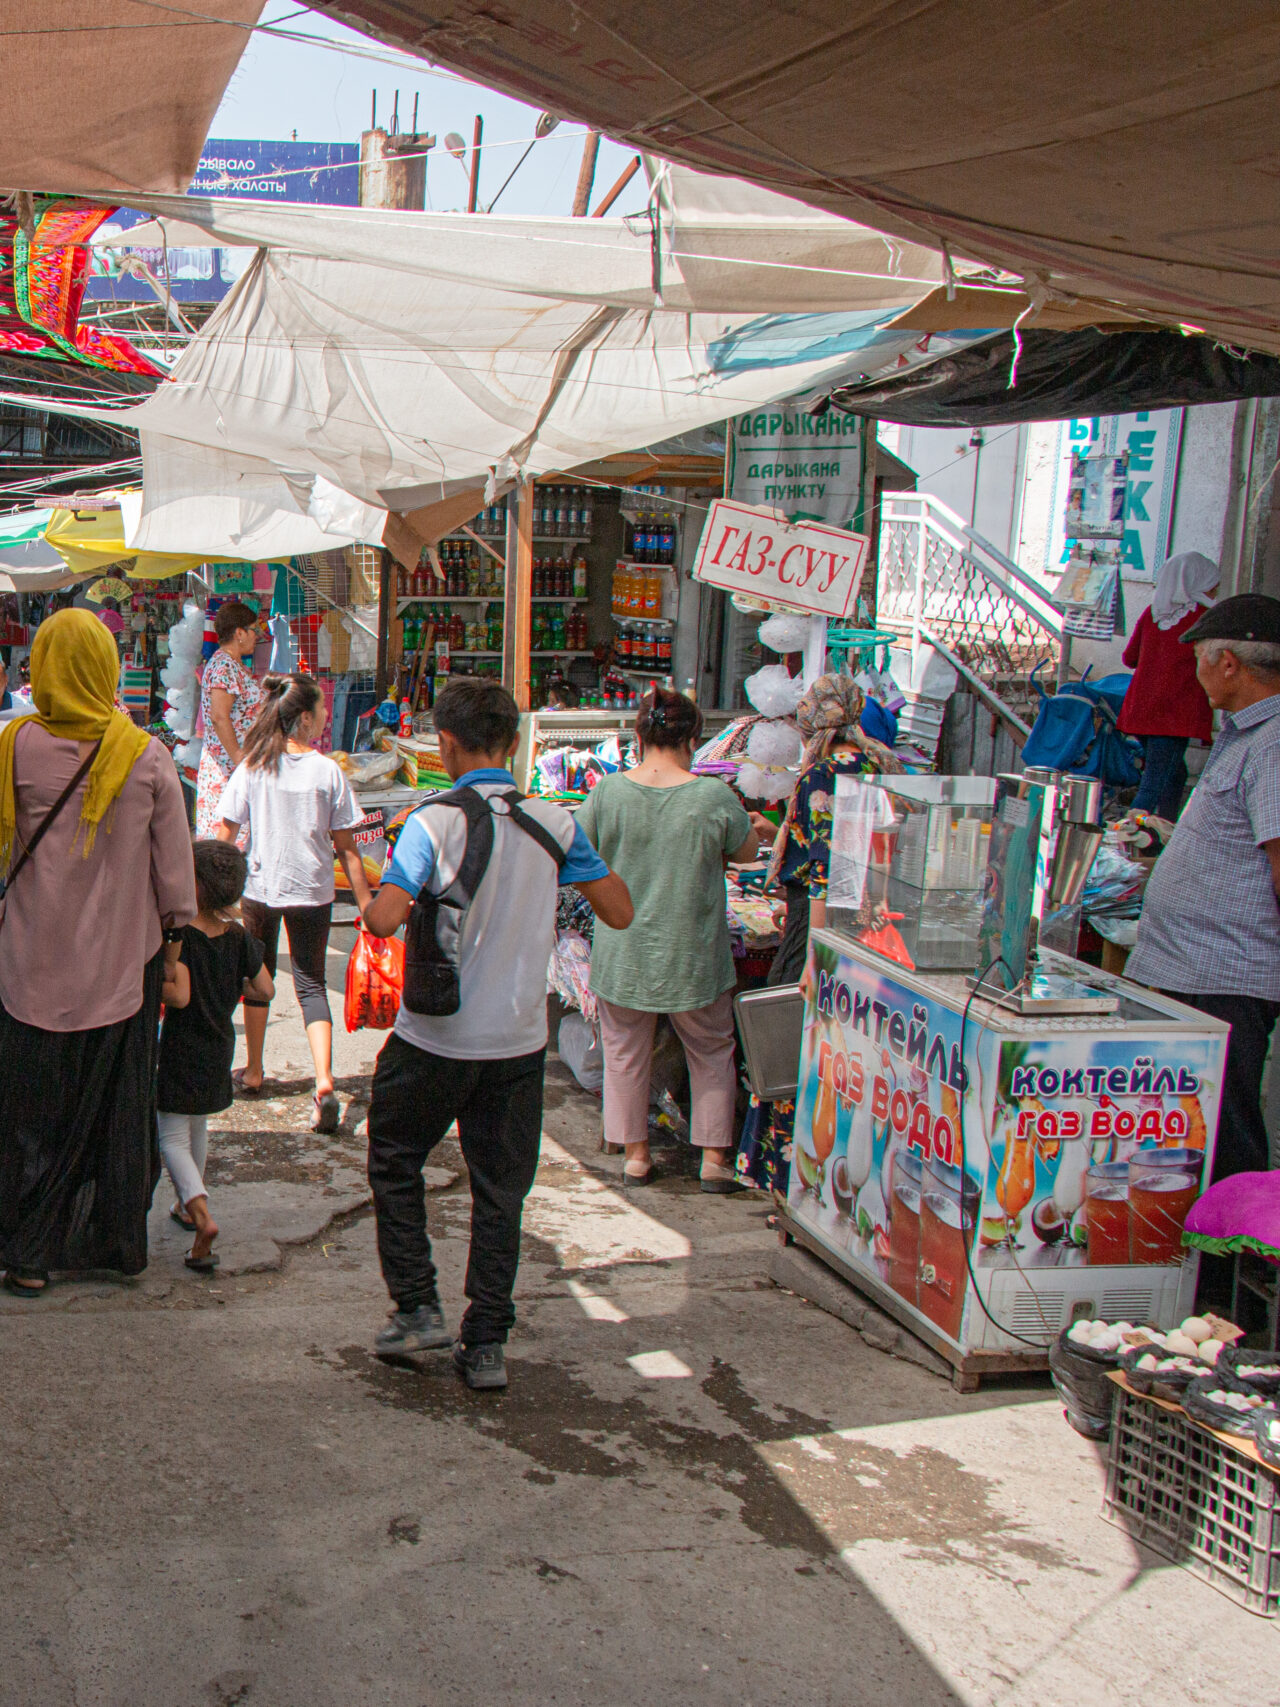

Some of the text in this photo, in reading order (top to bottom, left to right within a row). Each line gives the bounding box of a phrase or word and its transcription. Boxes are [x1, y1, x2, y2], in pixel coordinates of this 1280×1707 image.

[232, 180, 287, 193] халаты
[738, 412, 856, 438] ДАРЫКАНА
[746, 462, 841, 478] ДАРЫКАНА
[764, 483, 826, 500] ПУНКТУ
[710, 525, 850, 593] ГАЗ-СУУ
[818, 969, 970, 1092] коктейль
[1011, 1056, 1201, 1097] коктейль
[818, 1039, 955, 1168] газ вода
[1016, 1109, 1188, 1142] газ вода
